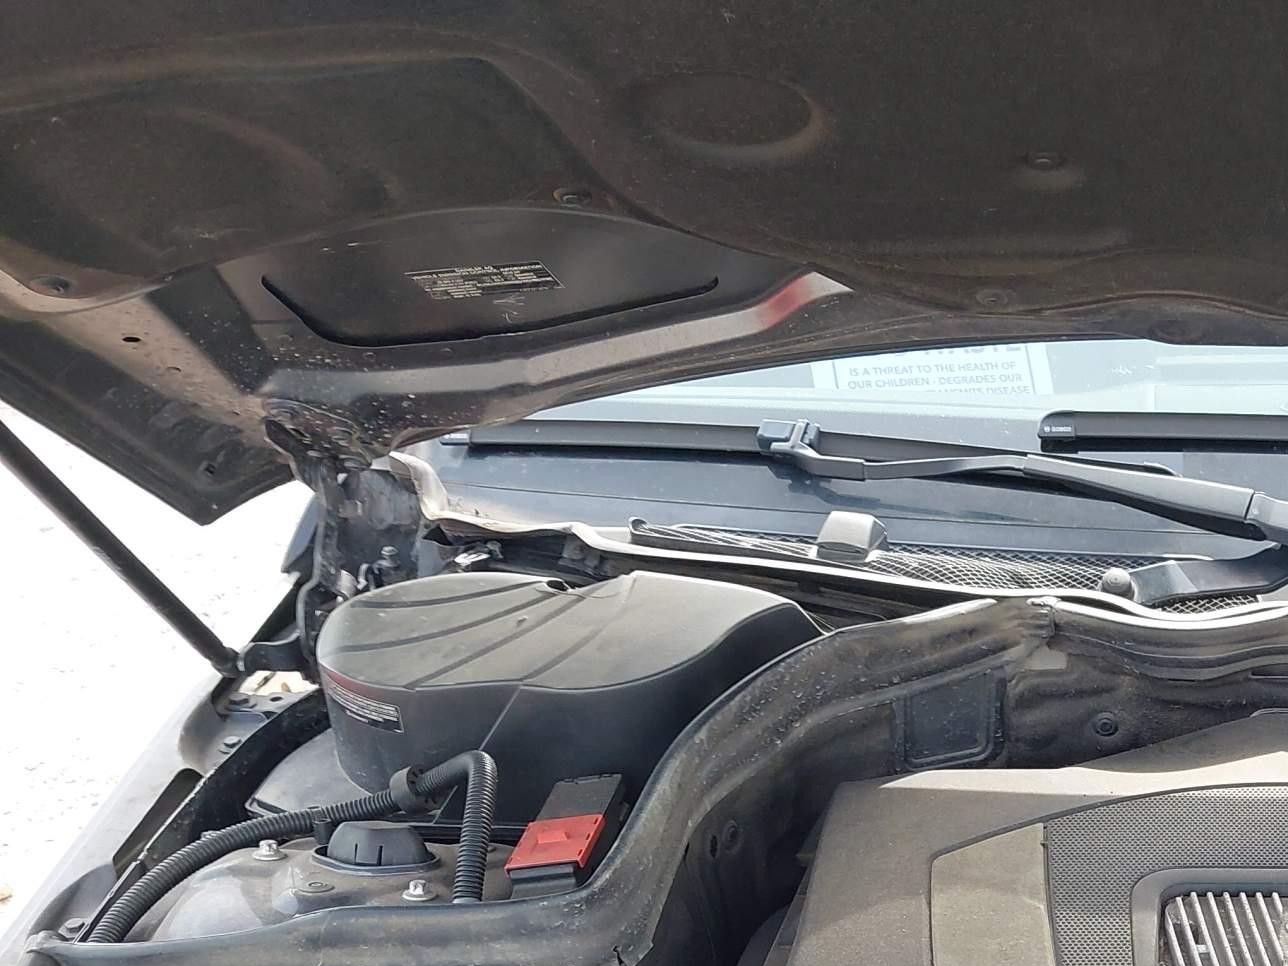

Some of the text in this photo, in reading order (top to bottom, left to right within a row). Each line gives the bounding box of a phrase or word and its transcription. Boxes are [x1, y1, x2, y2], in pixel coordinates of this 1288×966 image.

[849, 361, 1016, 376] IS A THREAT TO THE HEALTH OF
[847, 380, 872, 390] OUR
[874, 377, 930, 388] CHILDREN
[938, 375, 997, 385] DEGRADES
[999, 373, 1022, 383] OUR
